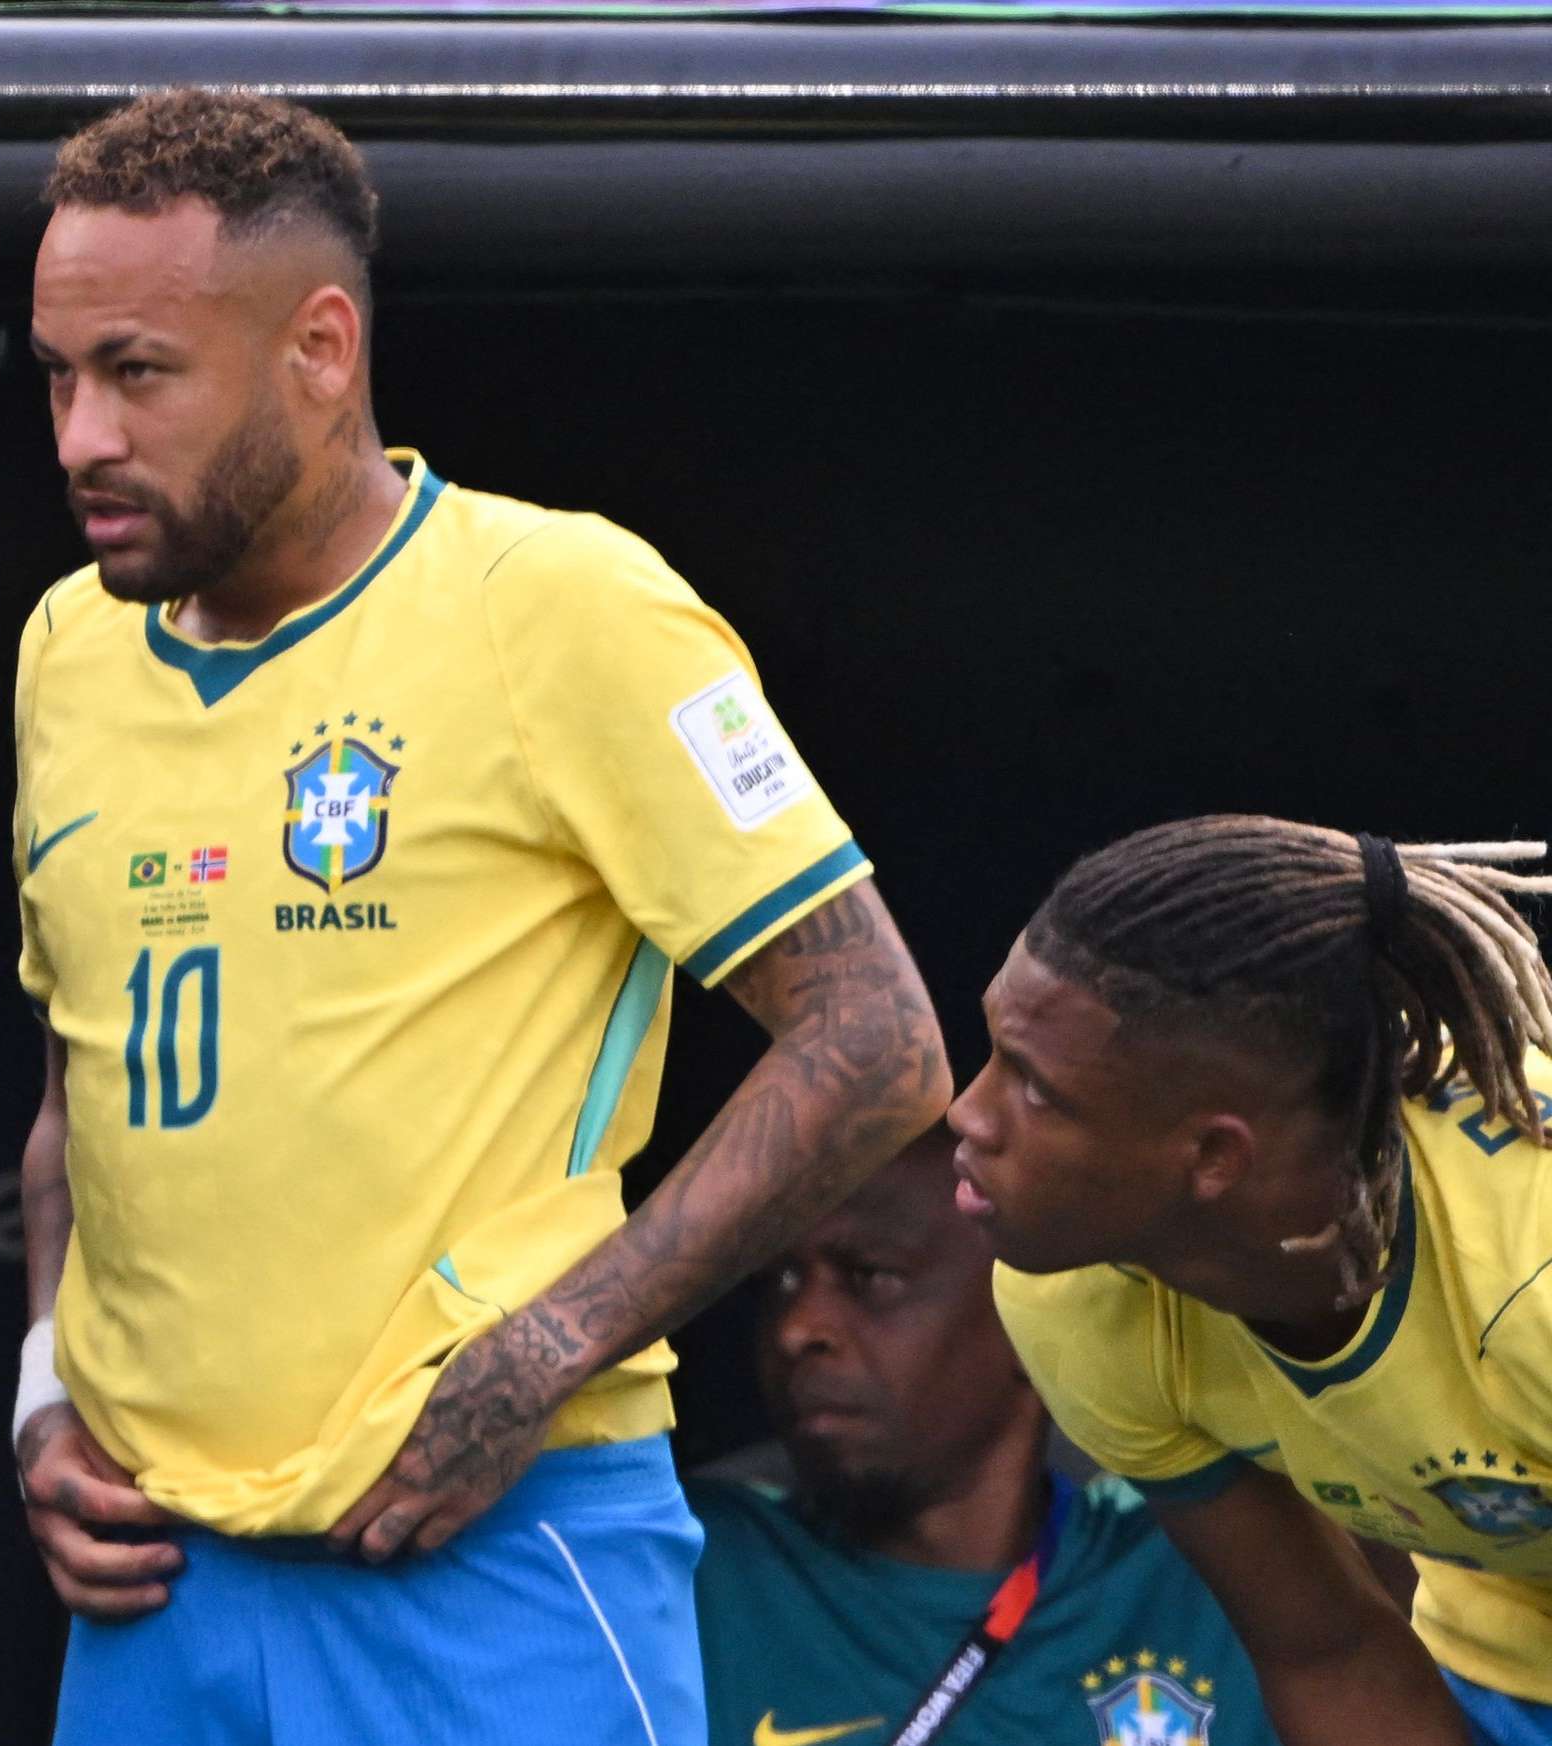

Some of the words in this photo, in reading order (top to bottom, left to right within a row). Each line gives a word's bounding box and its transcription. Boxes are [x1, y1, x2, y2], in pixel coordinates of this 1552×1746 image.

[314, 800, 356, 817] CBF
[275, 902, 397, 931] BRASIL
[125, 945, 220, 1130] 10
